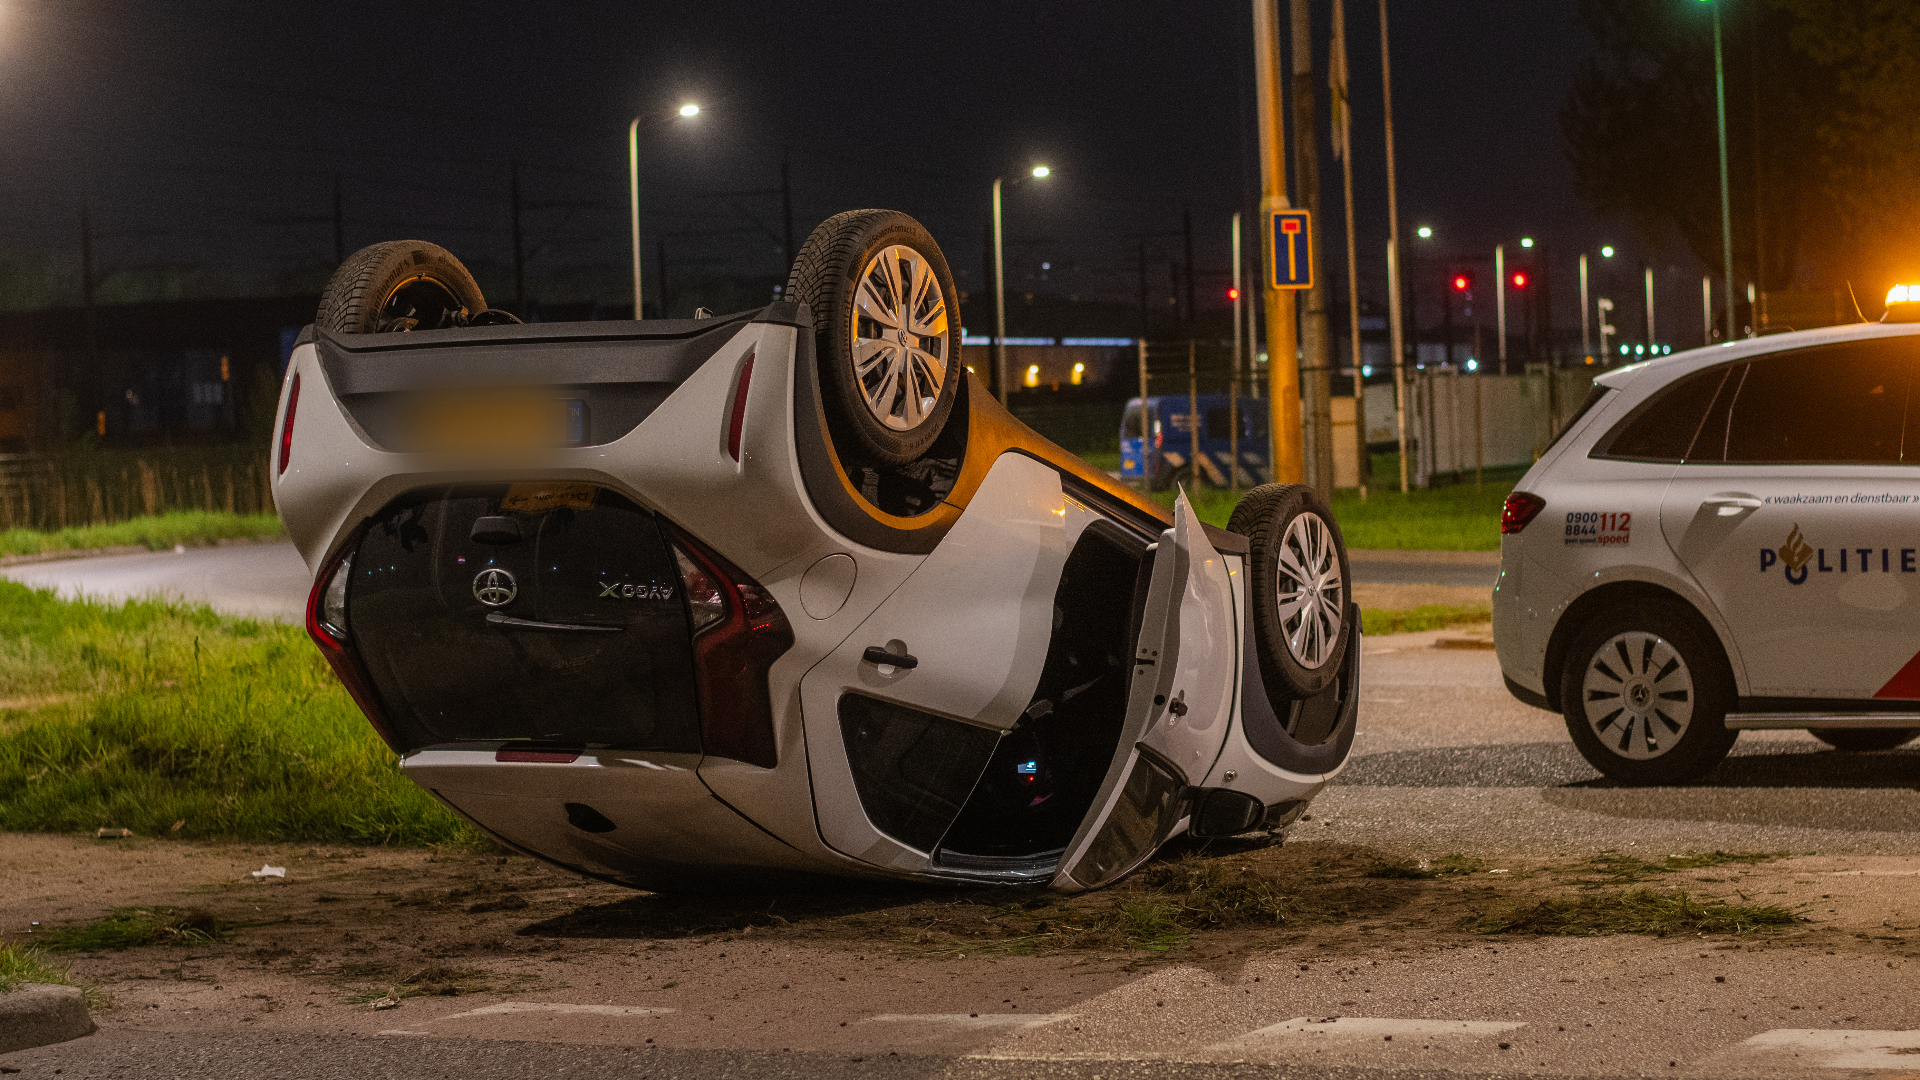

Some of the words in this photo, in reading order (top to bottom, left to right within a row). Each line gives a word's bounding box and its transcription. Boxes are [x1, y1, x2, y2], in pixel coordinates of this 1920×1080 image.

[568, 407, 580, 417] NL
[1774, 493, 1833, 504] waakzaam
[1834, 495, 1849, 503] en
[1850, 492, 1911, 503] dienstbaar
[1566, 512, 1598, 523] 0900
[1600, 512, 1631, 532] 112
[1565, 525, 1596, 536] 8844
[1597, 533, 1630, 547] spoed
[1760, 548, 1917, 585] POLITIE
